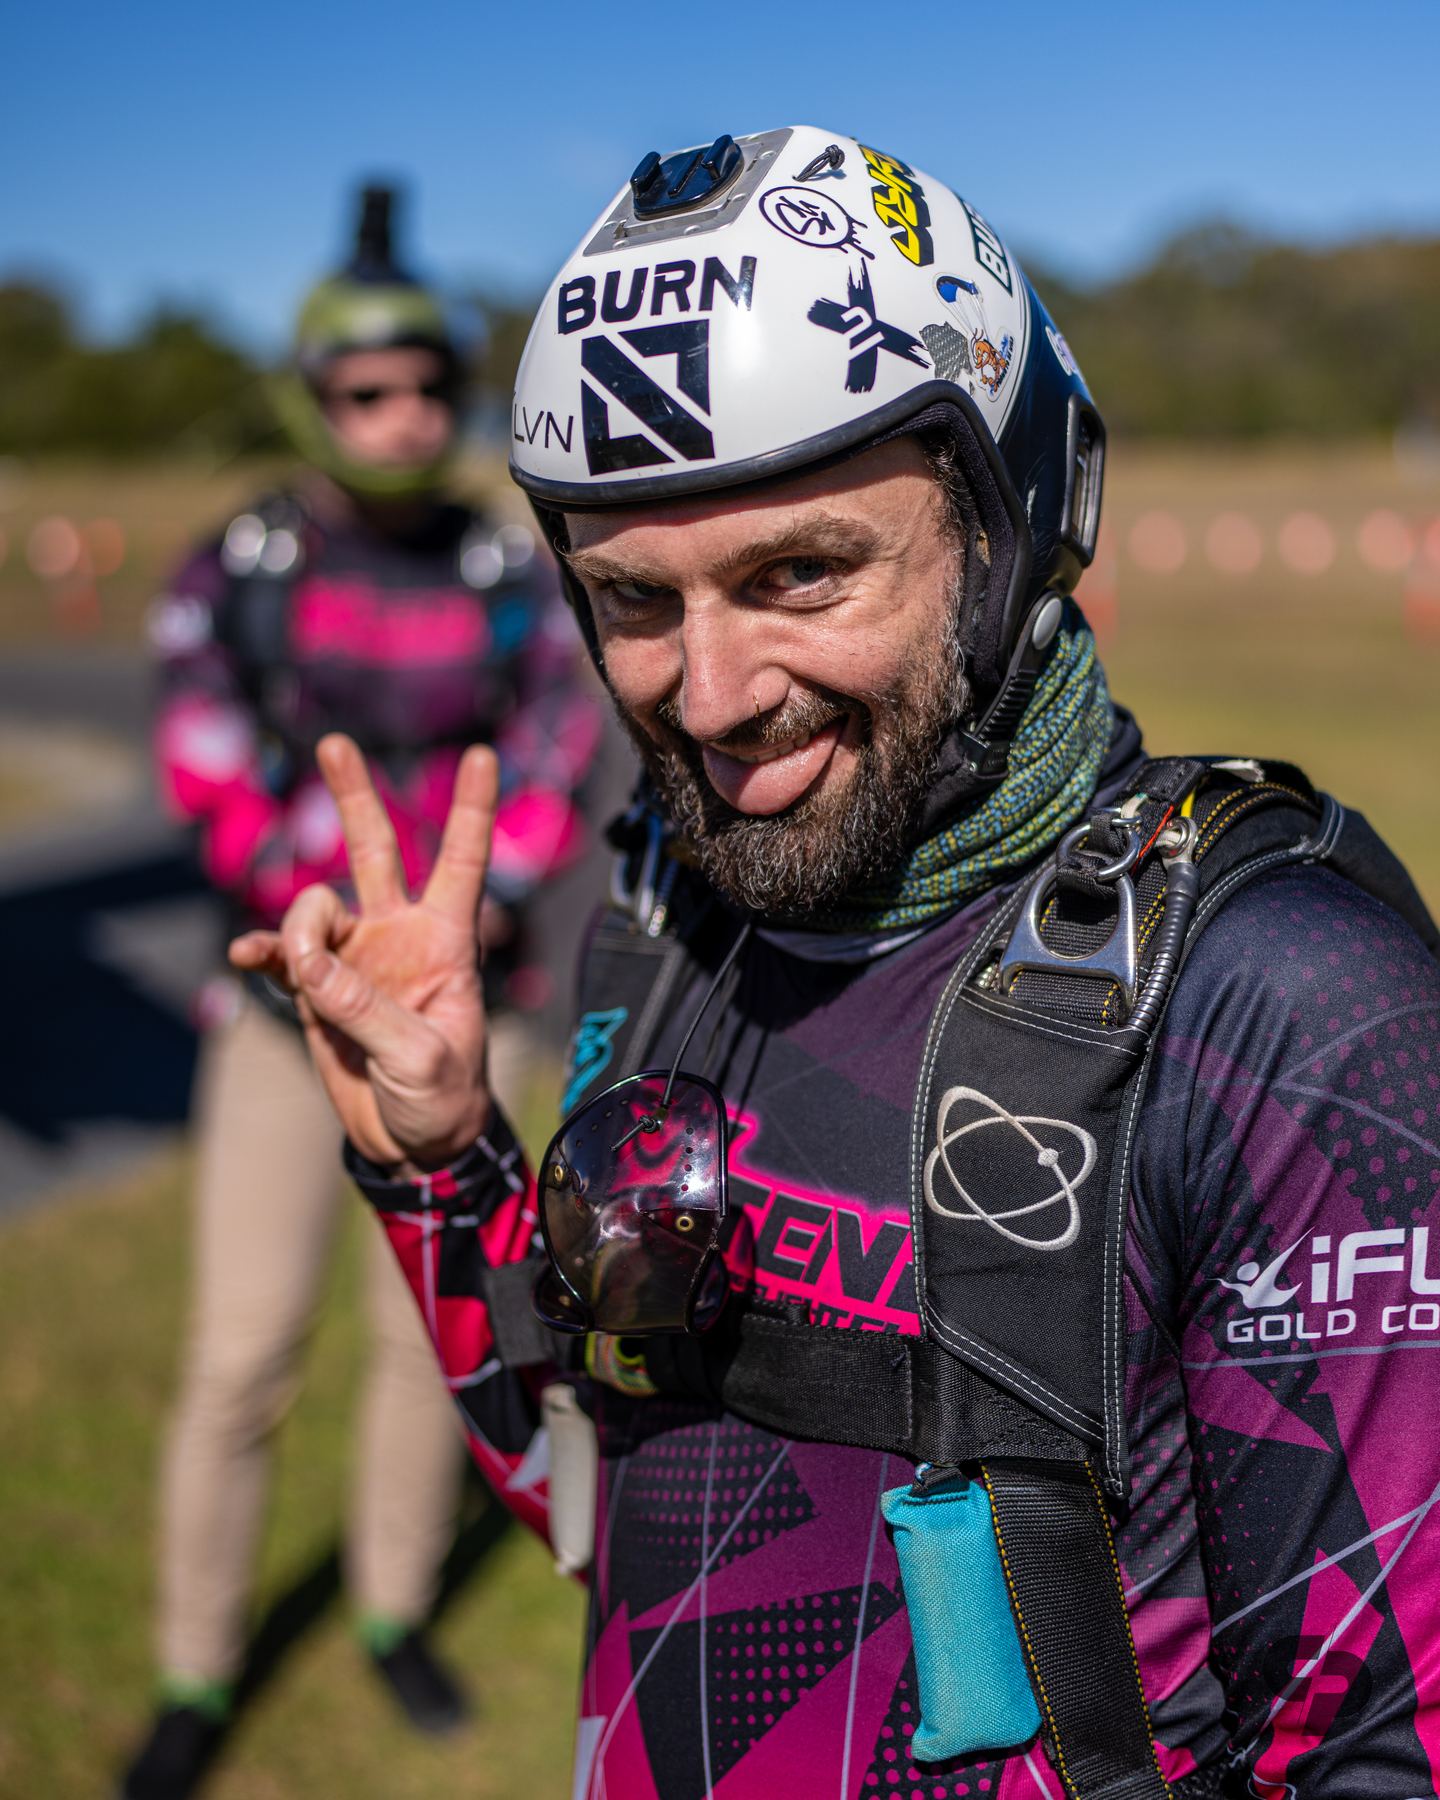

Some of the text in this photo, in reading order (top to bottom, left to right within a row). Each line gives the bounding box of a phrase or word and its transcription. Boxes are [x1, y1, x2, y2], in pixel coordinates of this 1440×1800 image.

[964, 199, 1011, 288] BU
[557, 256, 757, 335] BURN
[1227, 1303, 1440, 1343] GOLD CO
